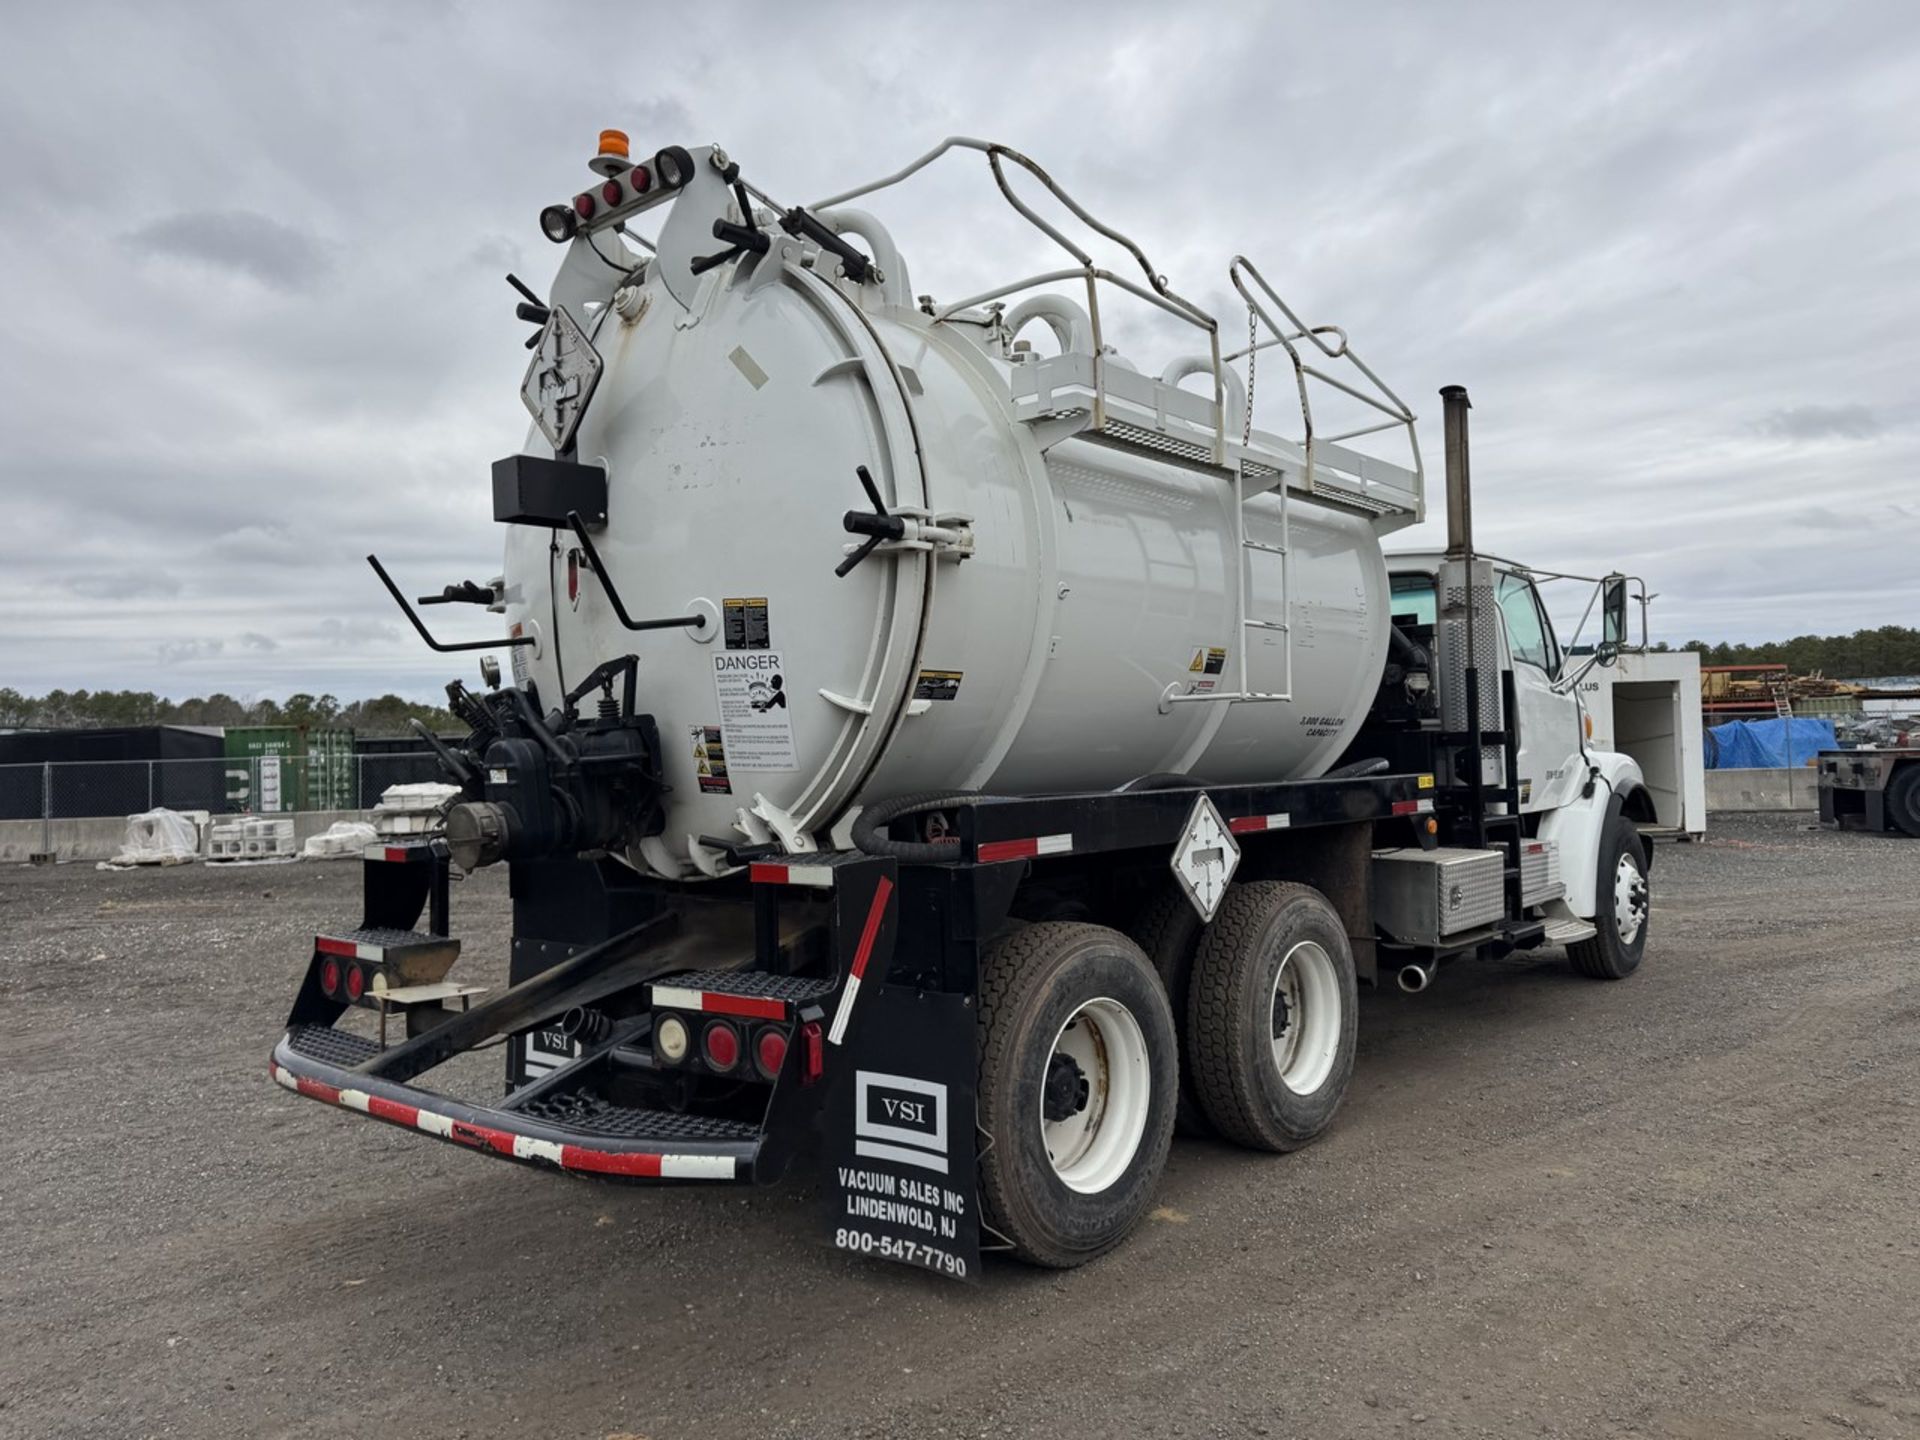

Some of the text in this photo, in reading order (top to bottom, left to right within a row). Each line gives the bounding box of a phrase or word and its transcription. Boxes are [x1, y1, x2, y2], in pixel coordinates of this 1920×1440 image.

[715, 654, 780, 671] DANGER
[1306, 728, 1338, 737] CAPACITY
[1319, 716, 1345, 726] GALLON
[542, 1031, 568, 1051] VSI
[882, 1098, 925, 1124] VSI
[838, 1166, 964, 1215] VACUUM SALES INC
[847, 1195, 956, 1239] LINDENWOLD, NJ
[835, 1228, 967, 1278] 800-547-7790
